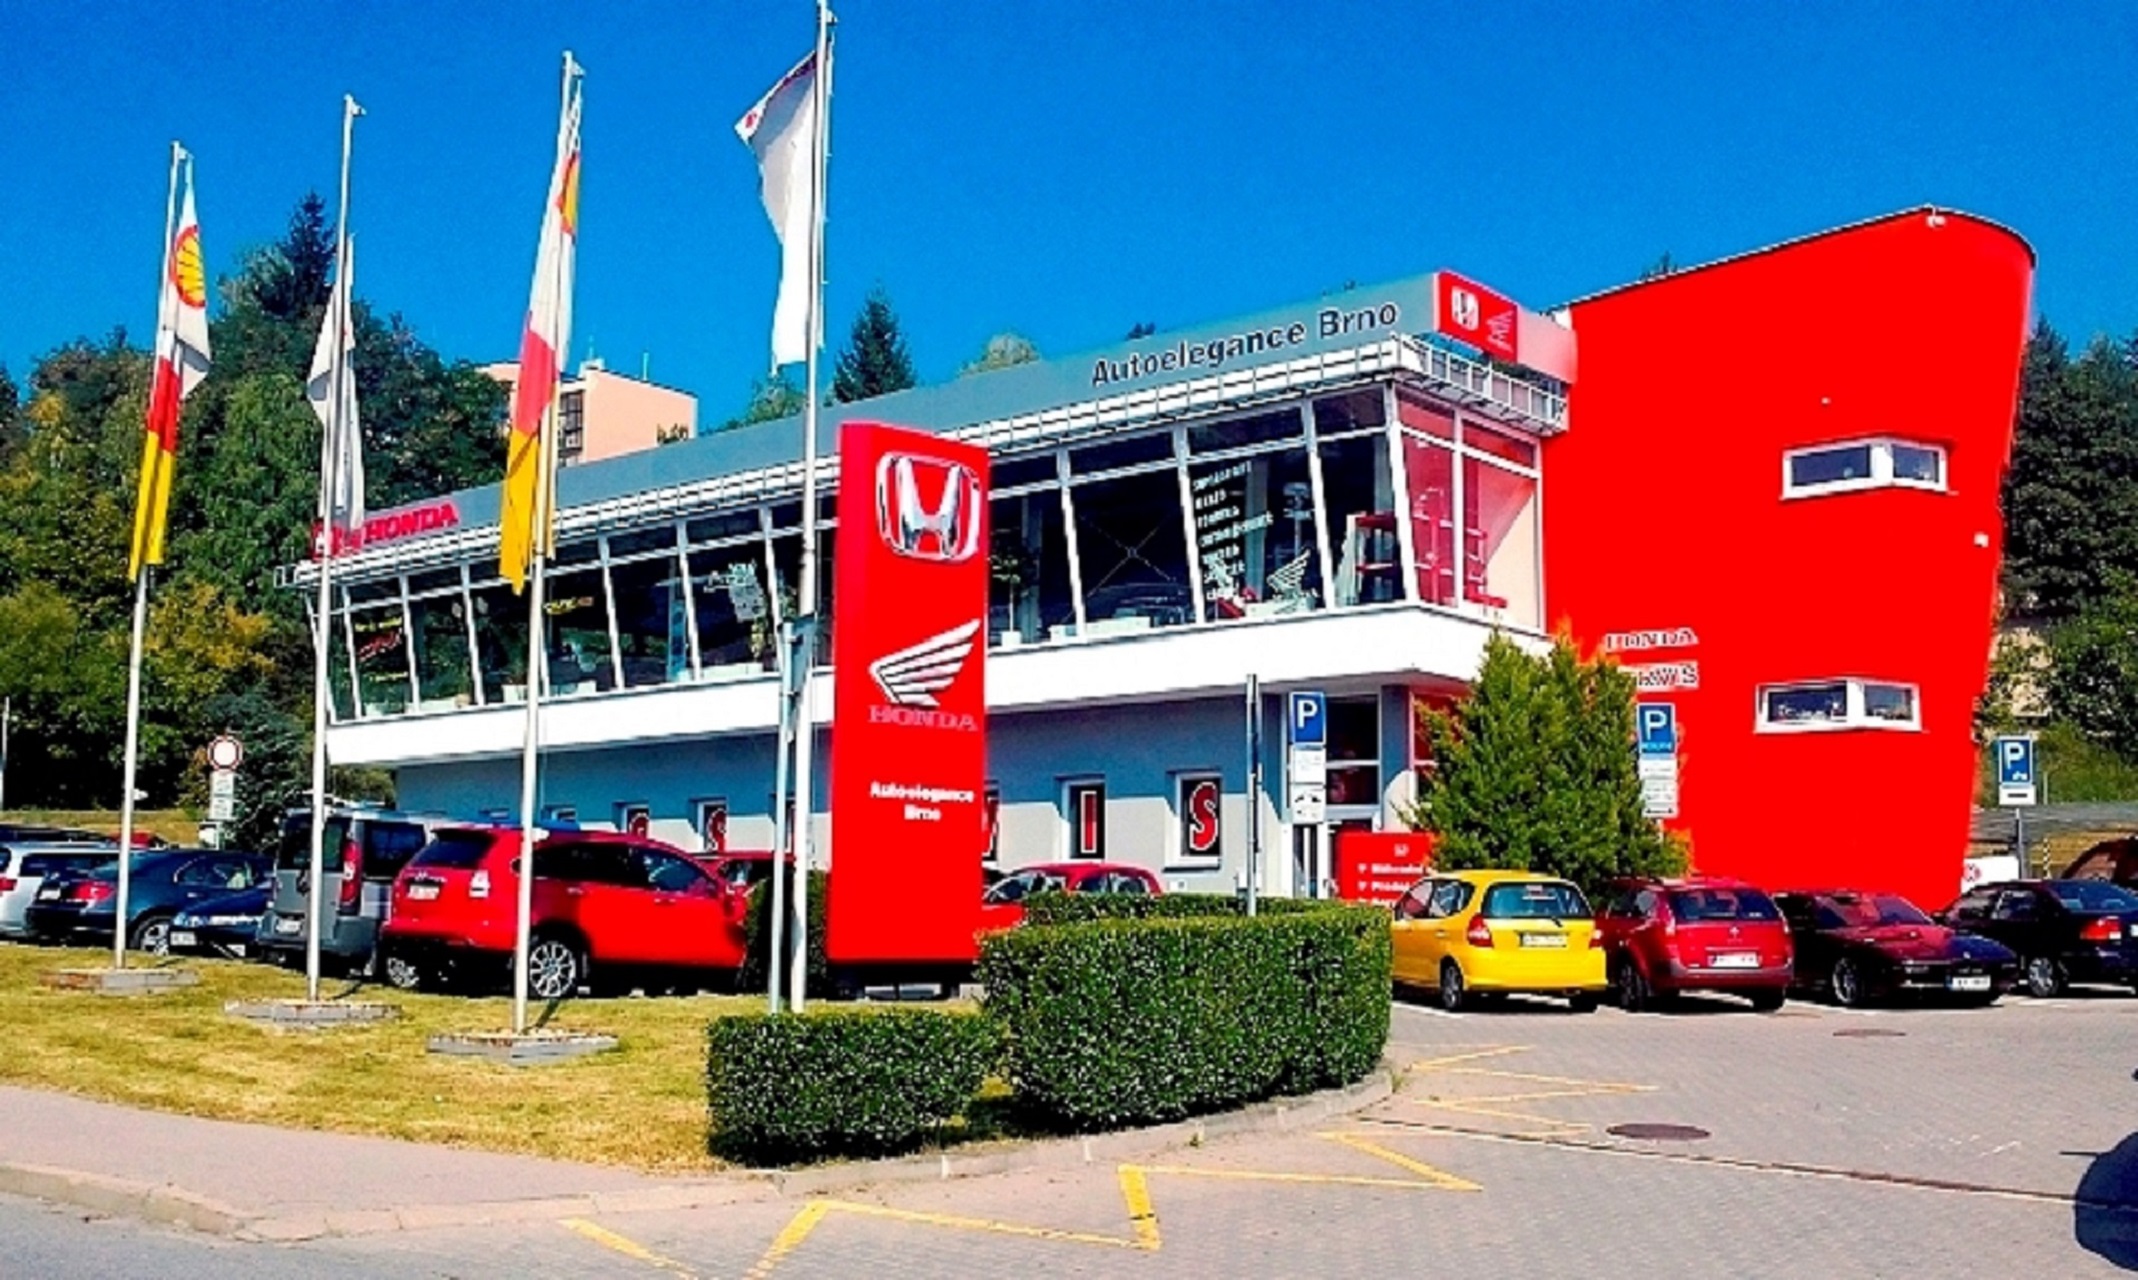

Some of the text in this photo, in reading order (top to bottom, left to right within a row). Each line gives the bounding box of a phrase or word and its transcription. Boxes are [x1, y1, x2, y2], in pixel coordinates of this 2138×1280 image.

[1092, 302, 1398, 388] Autoelegance Brno
[362, 502, 459, 545] HONDA
[867, 704, 978, 732] HONDA
[1297, 700, 1317, 729] P
[1645, 710, 1667, 740] P
[2004, 742, 2025, 770] P
